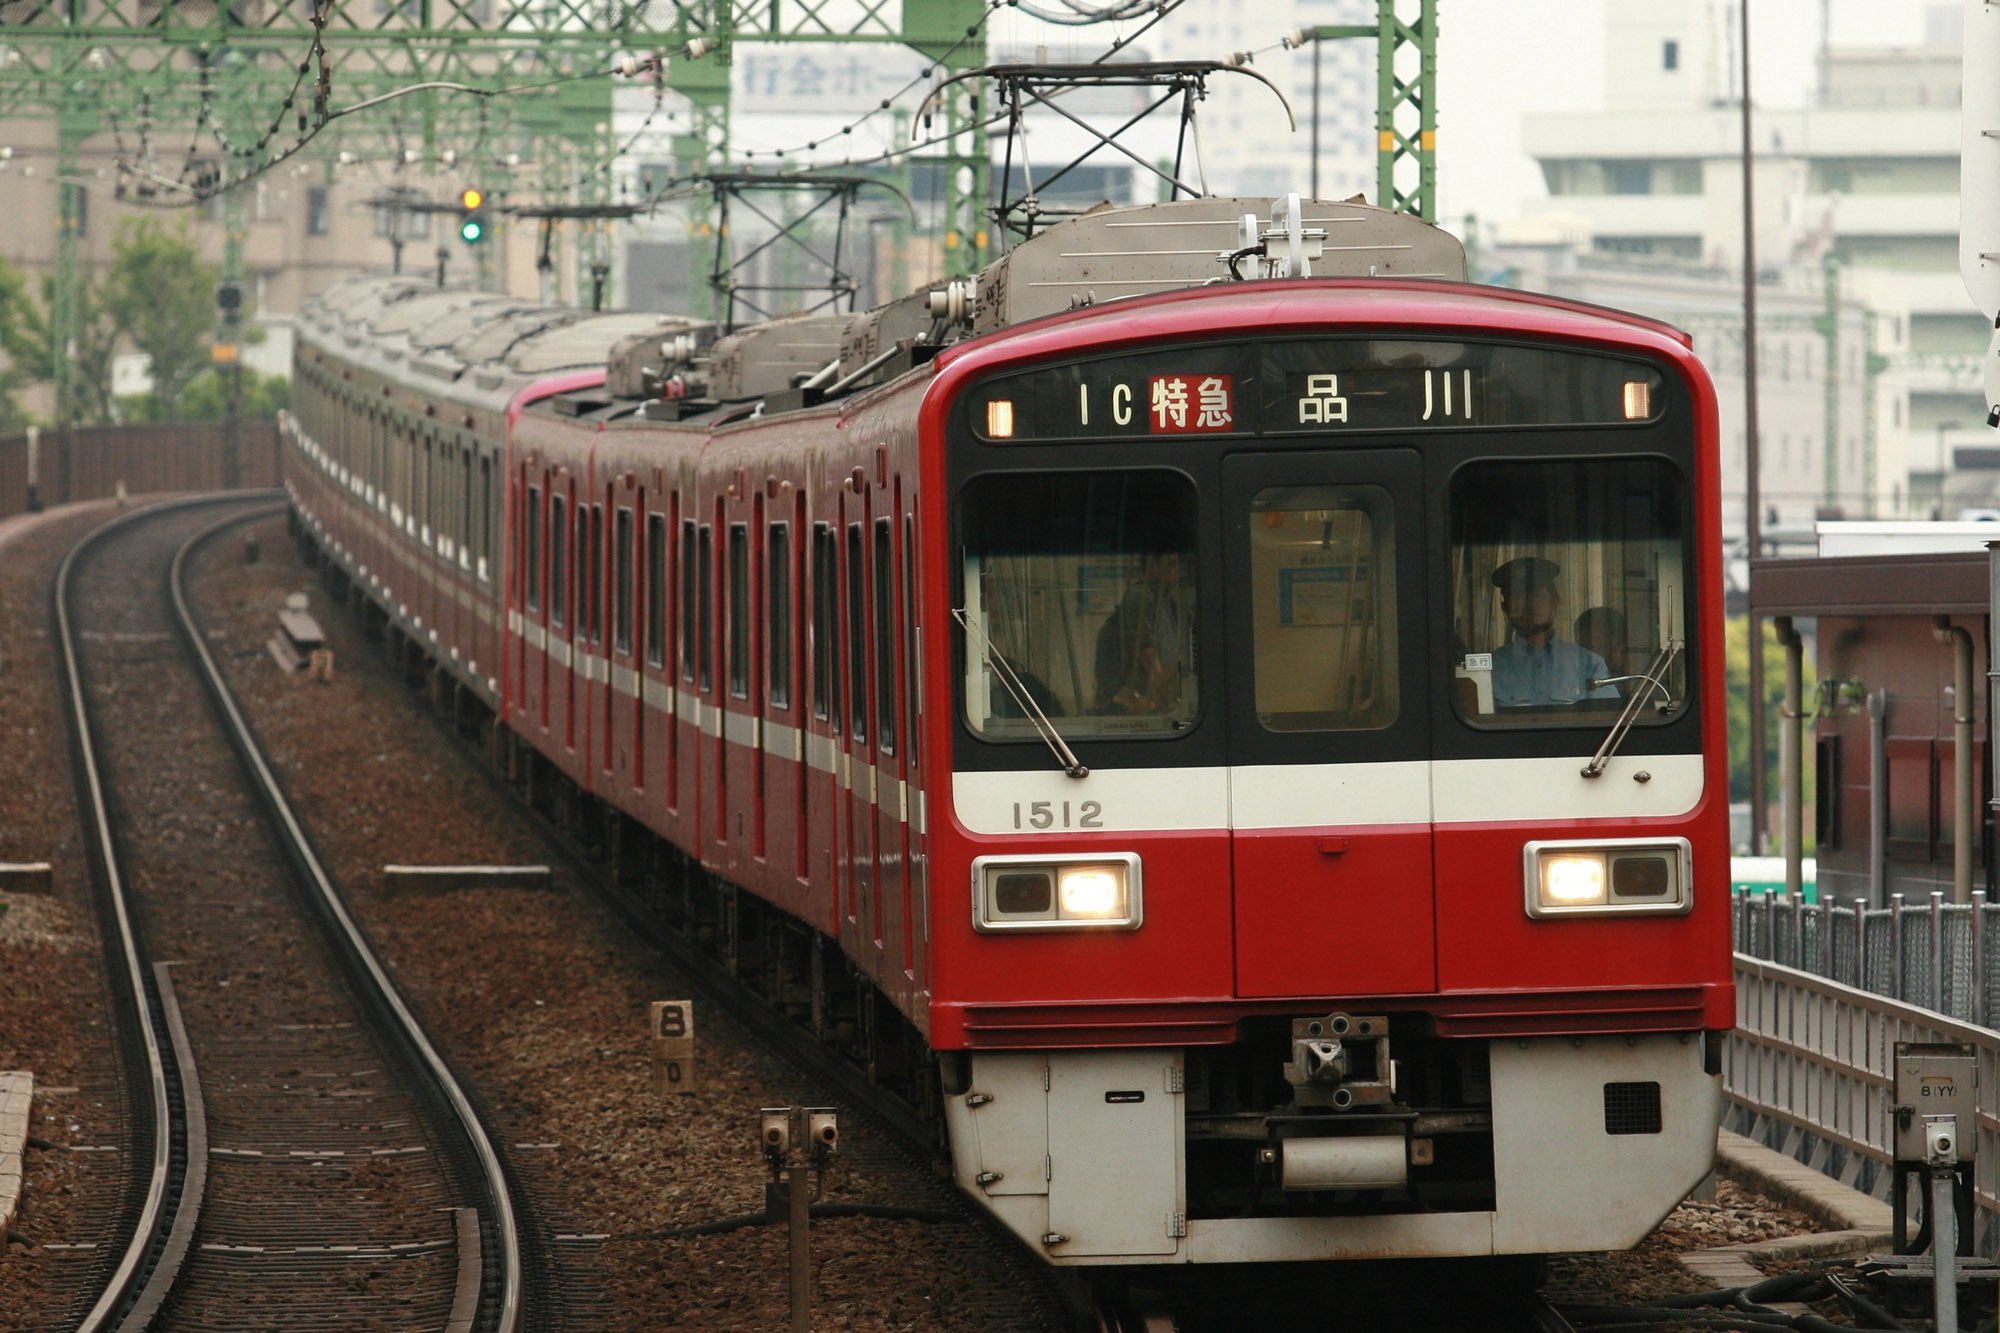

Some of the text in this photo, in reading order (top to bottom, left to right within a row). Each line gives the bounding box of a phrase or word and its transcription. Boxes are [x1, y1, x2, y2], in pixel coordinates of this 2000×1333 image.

[1151, 376, 1232, 429] 特急
[1013, 800, 1104, 830] 1512
[661, 1005, 686, 1037] 8
